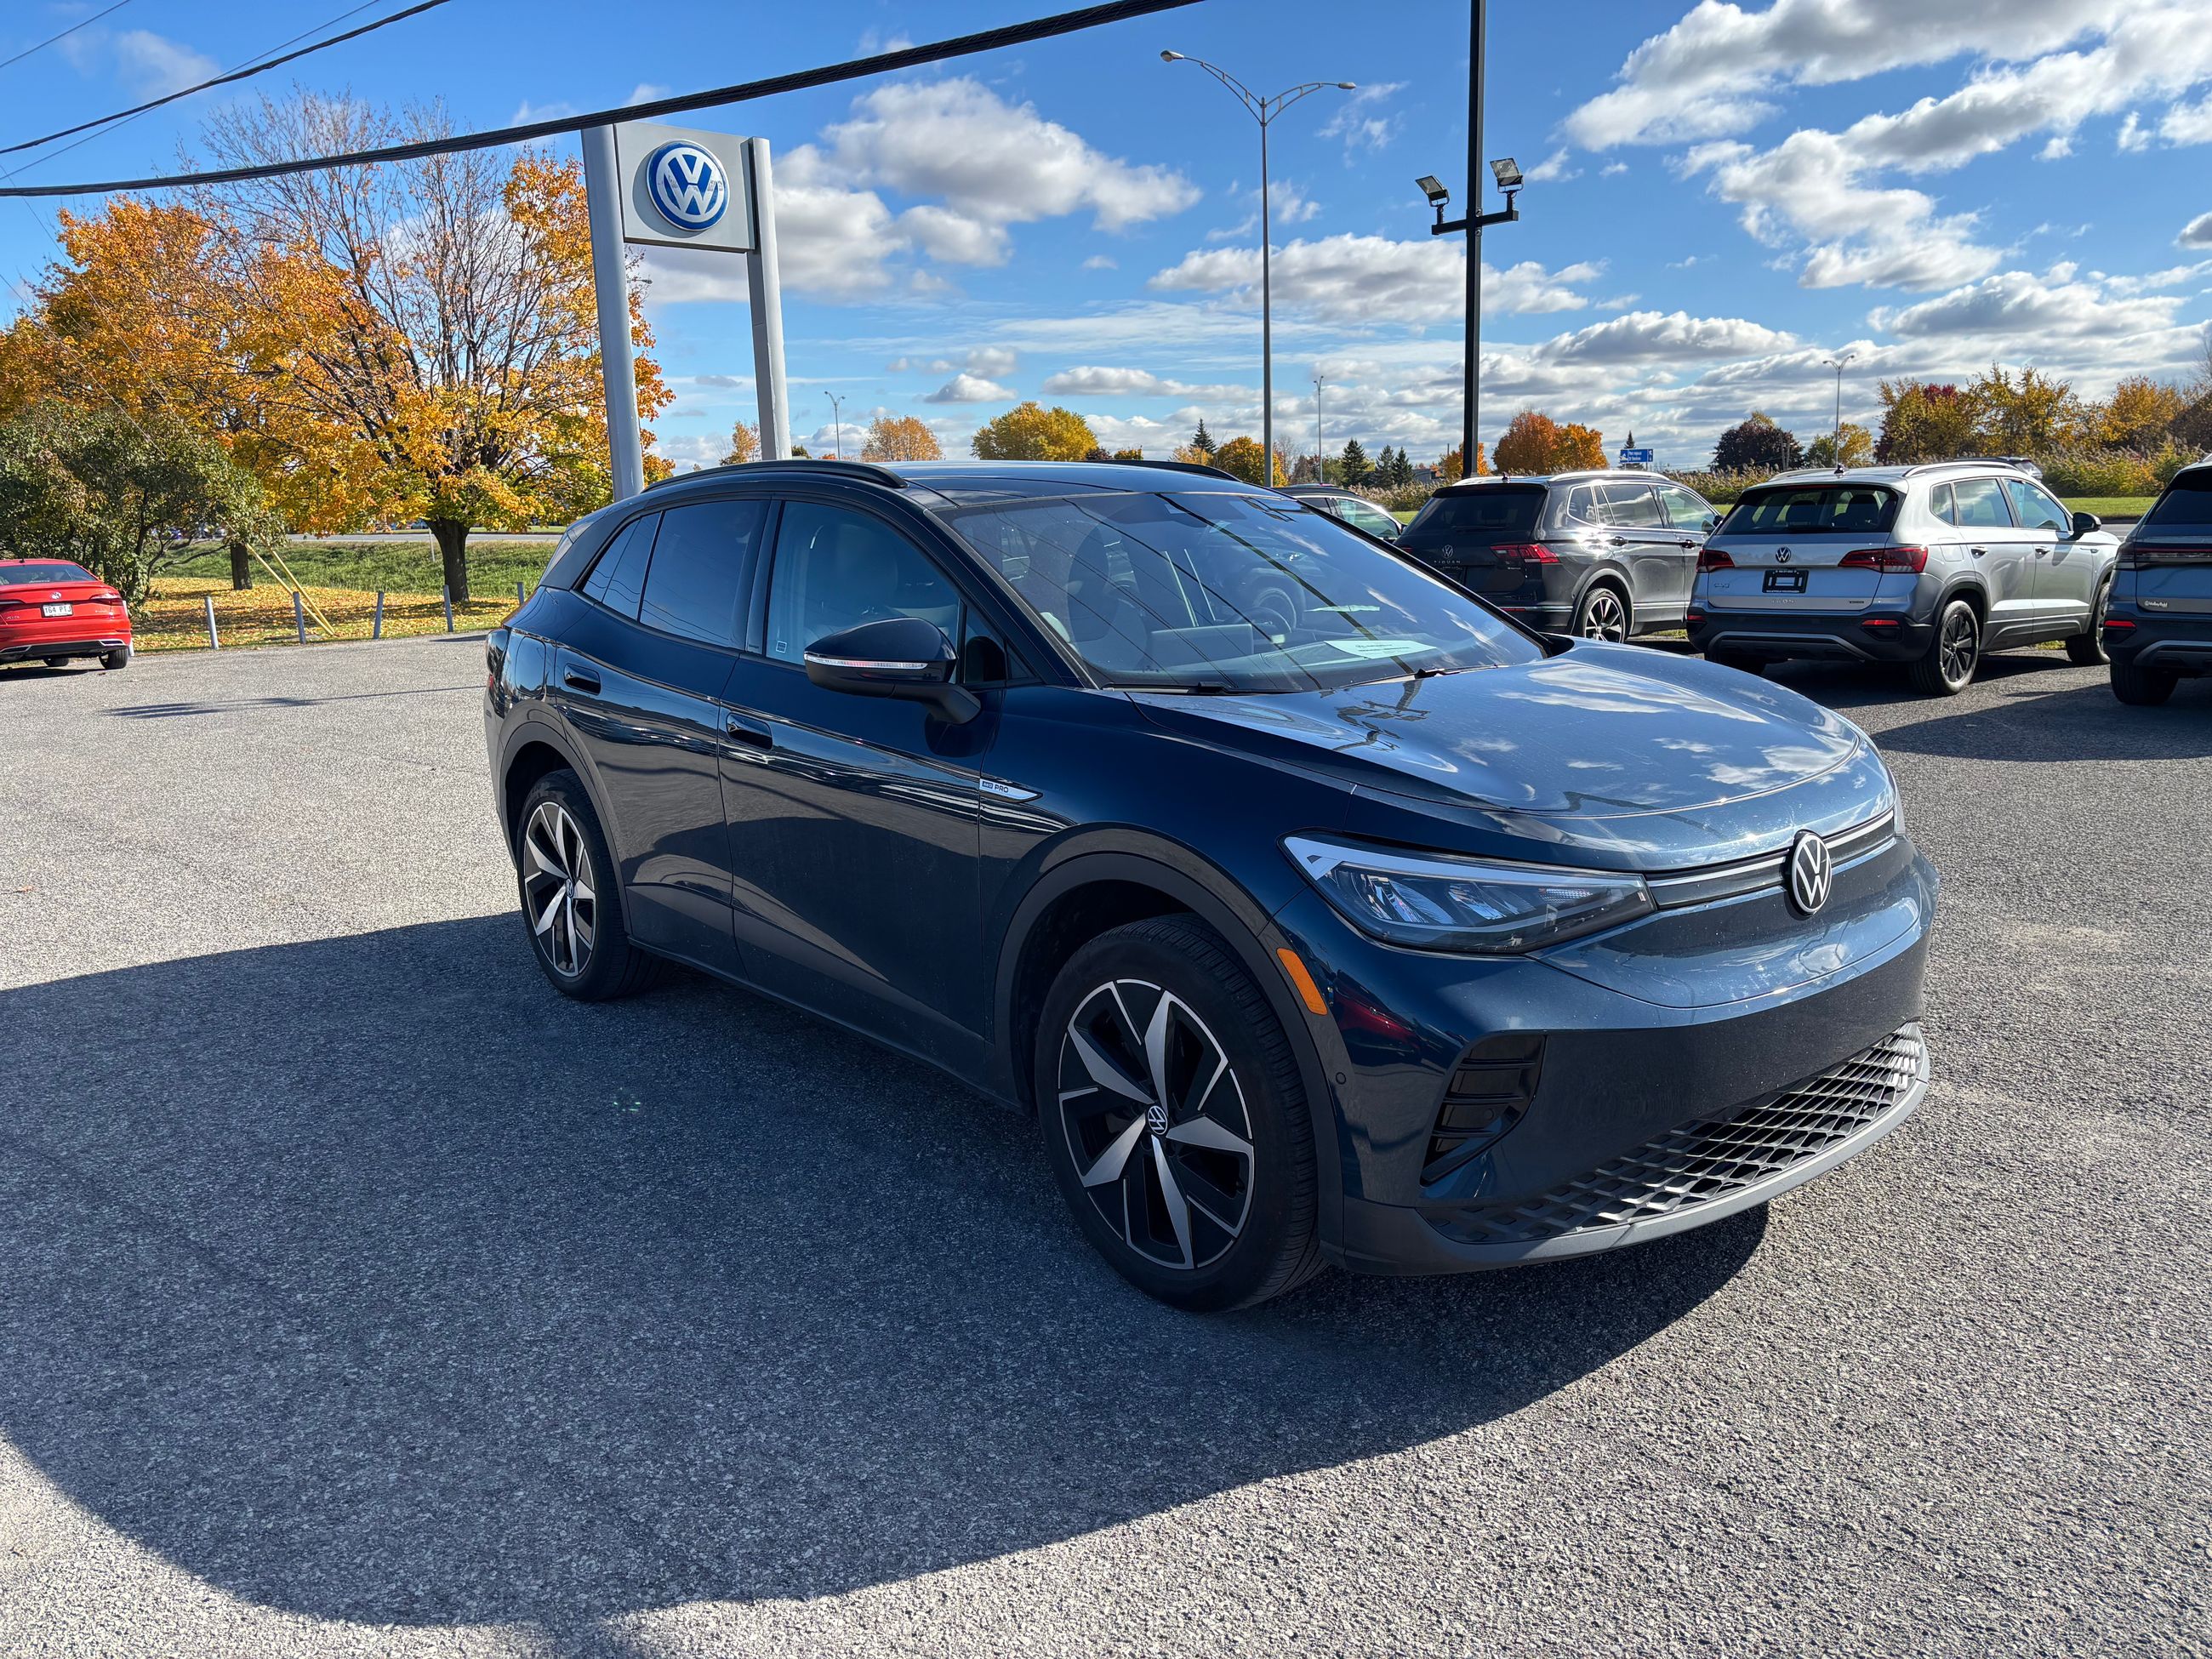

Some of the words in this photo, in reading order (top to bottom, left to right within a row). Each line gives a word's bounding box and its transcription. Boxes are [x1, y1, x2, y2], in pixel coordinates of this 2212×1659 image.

[655, 147, 725, 223] VW
[995, 784, 1009, 793] PRO
[1792, 834, 1832, 912] VW
